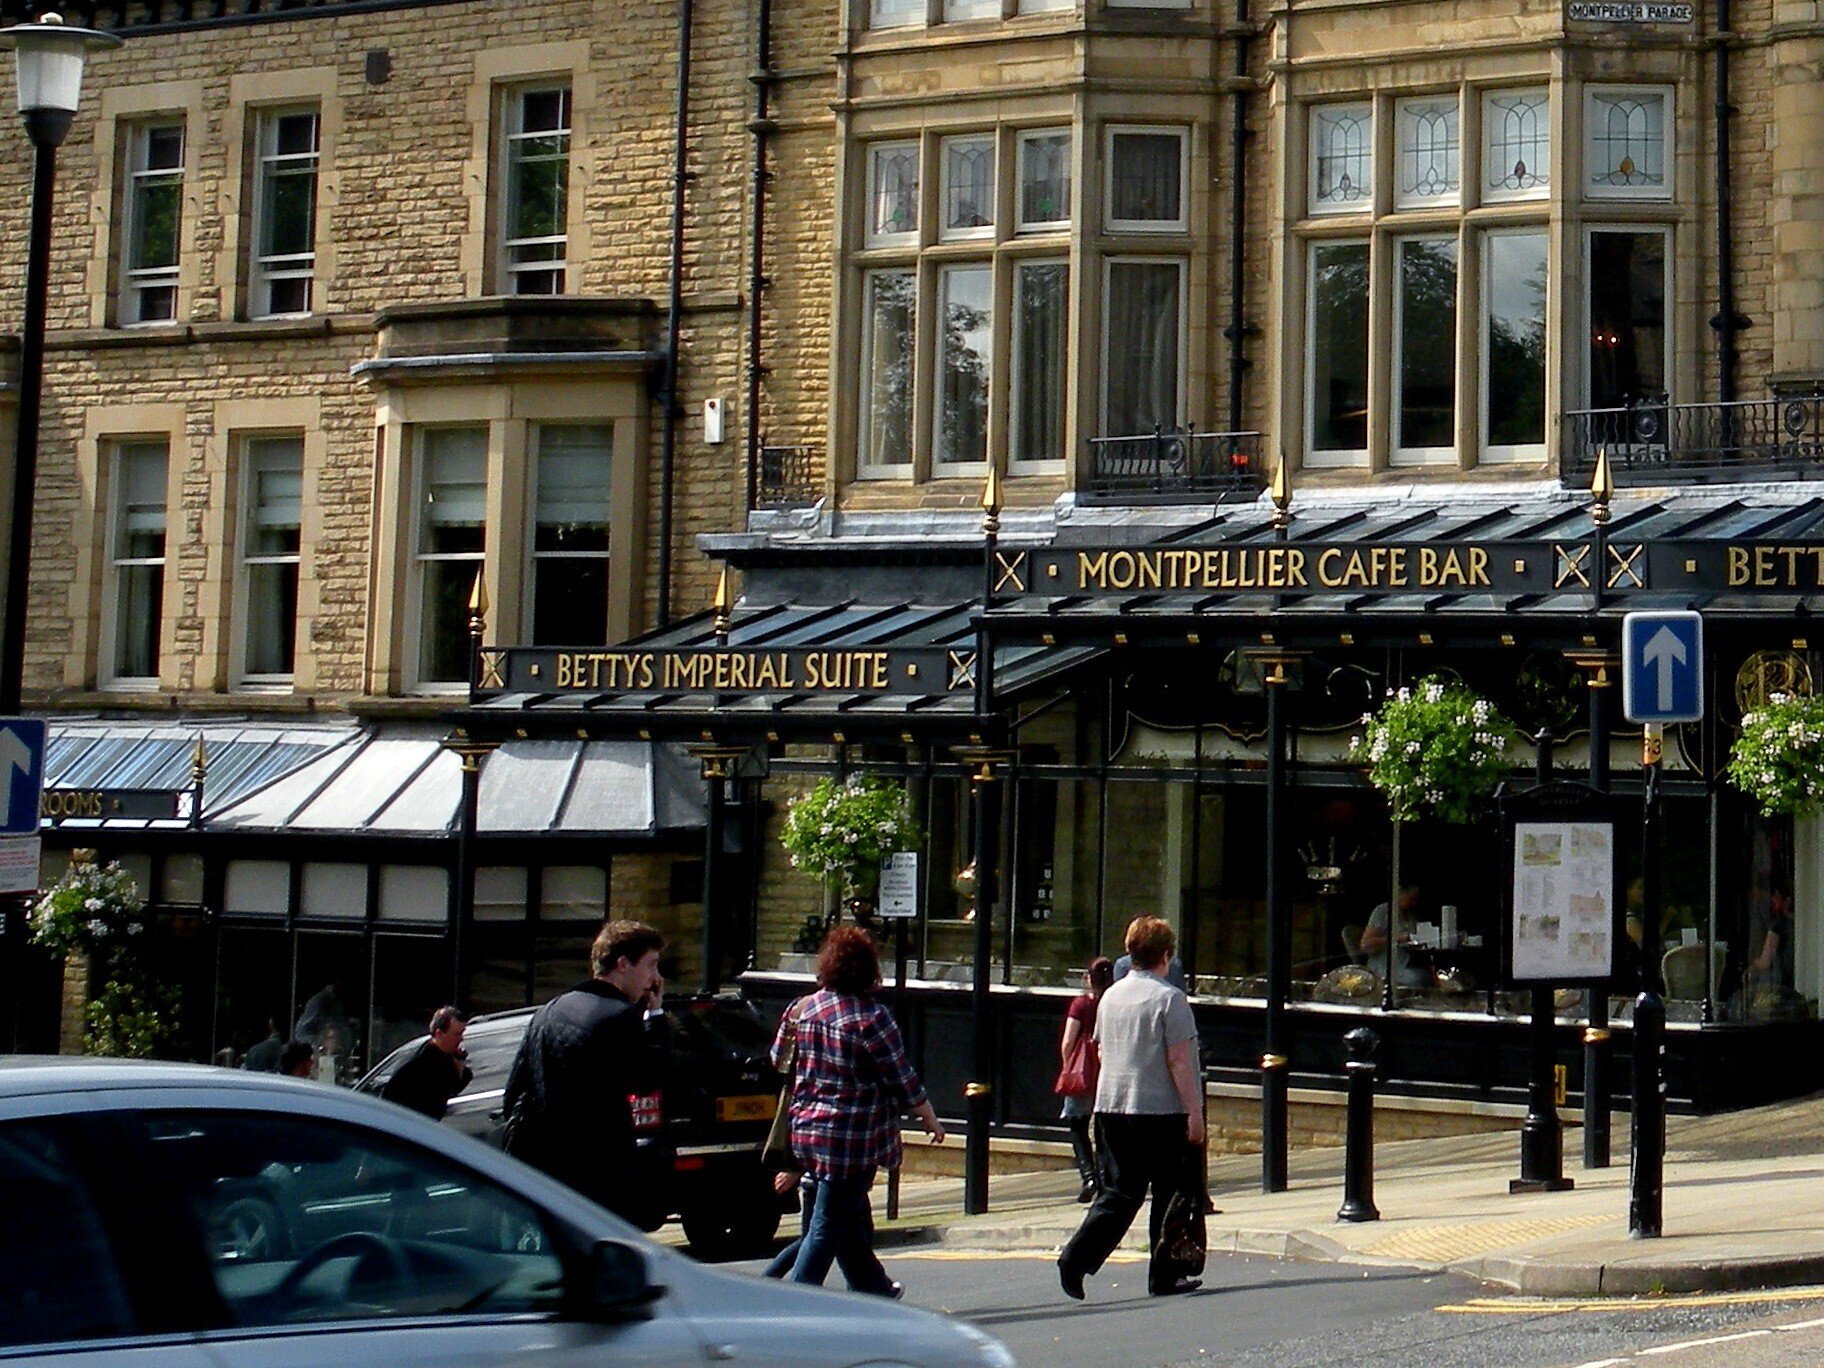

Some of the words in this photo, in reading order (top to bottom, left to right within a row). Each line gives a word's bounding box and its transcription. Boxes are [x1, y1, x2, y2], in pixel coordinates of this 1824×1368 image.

[1573, 5, 1643, 19] MONTPELLIER
[1648, 6, 1692, 20] PARADE
[1077, 549, 1309, 590] MONTPELLIER
[1317, 547, 1408, 588] CAFE
[1420, 547, 1491, 587] BAR
[556, 653, 654, 688] BETTYS
[663, 653, 794, 688] IMPERIAL
[804, 652, 889, 688] SUITE
